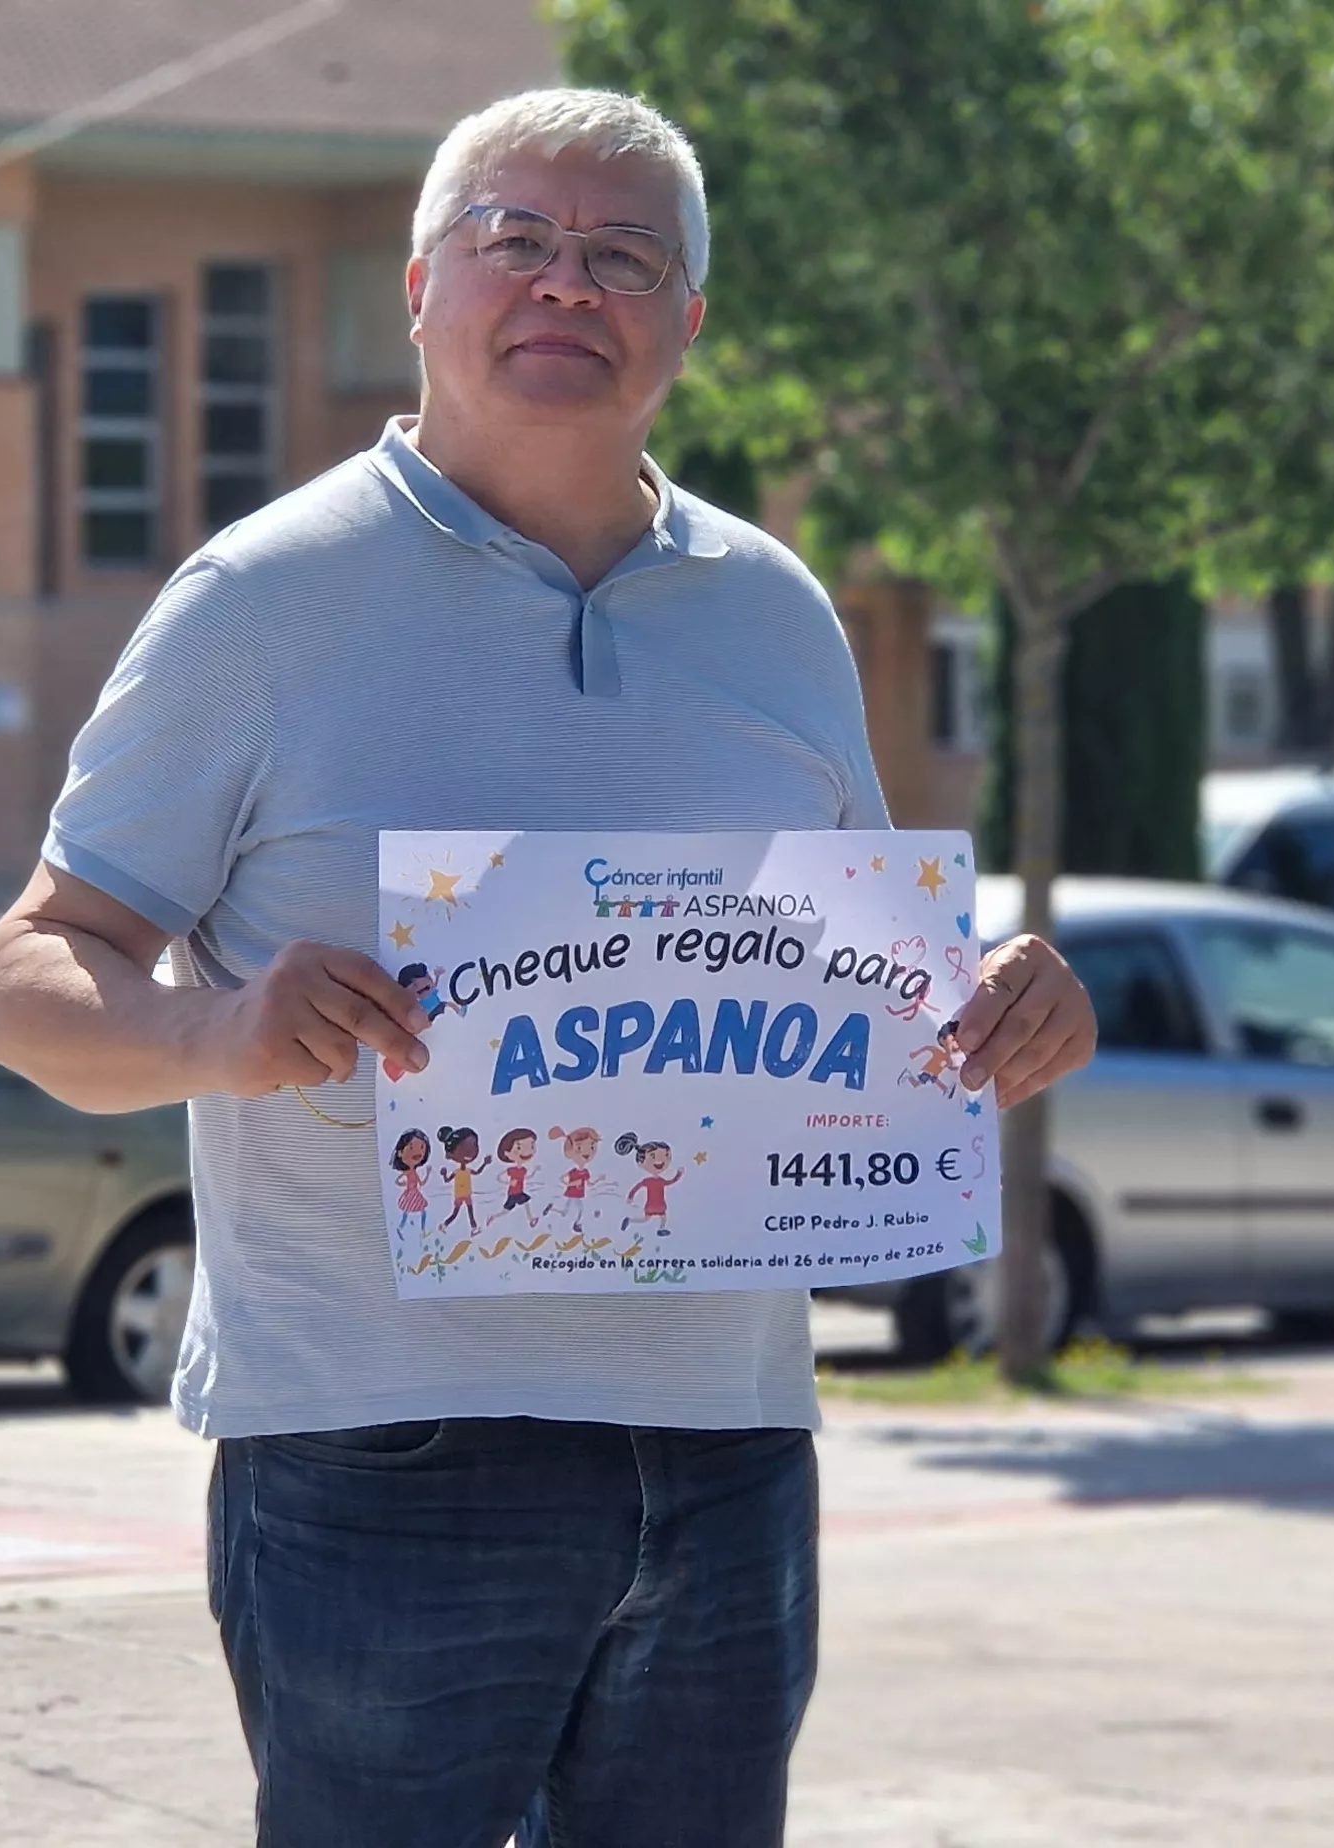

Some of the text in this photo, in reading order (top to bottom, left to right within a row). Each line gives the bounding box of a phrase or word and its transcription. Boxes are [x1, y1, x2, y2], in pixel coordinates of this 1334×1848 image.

[584, 858, 724, 891] Cáncer infantil
[683, 894, 817, 917] ASPANOA
[449, 925, 932, 1006] Cheque regalo para
[491, 998, 871, 1096] ASPANOA
[806, 1114, 891, 1128] IMPORTE:
[766, 1148, 962, 1191] 1441,80 €
[764, 1211, 929, 1232] CEIP Pedro J. Rubio
[532, 1241, 945, 1273] Recogido en la carrera solidaria del 26 de mayo de 2026
